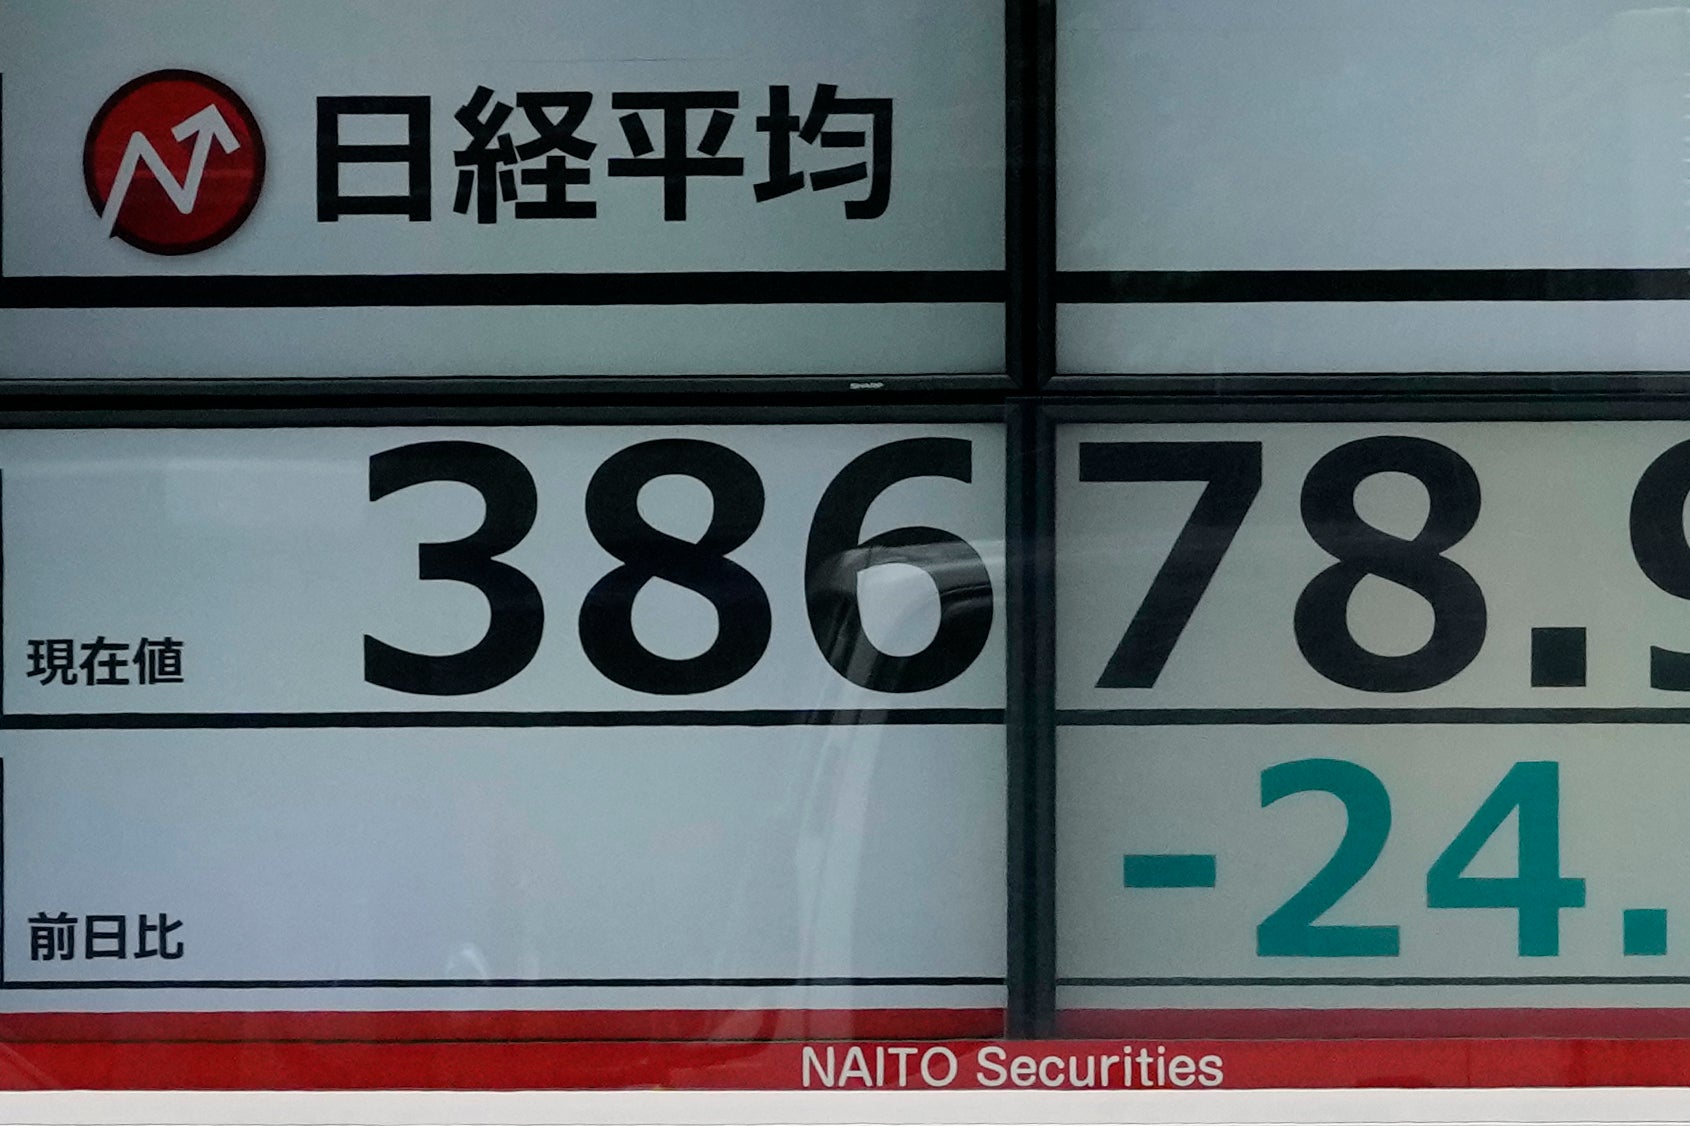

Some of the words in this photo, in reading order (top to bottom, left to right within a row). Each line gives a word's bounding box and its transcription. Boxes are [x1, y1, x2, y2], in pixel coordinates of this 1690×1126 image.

[316, 82, 894, 225] 日経平均
[26, 636, 184, 686] 現在値
[28, 911, 184, 961] 前日比
[802, 1045, 958, 1088] NAITO
[976, 1044, 1225, 1088] Securities
